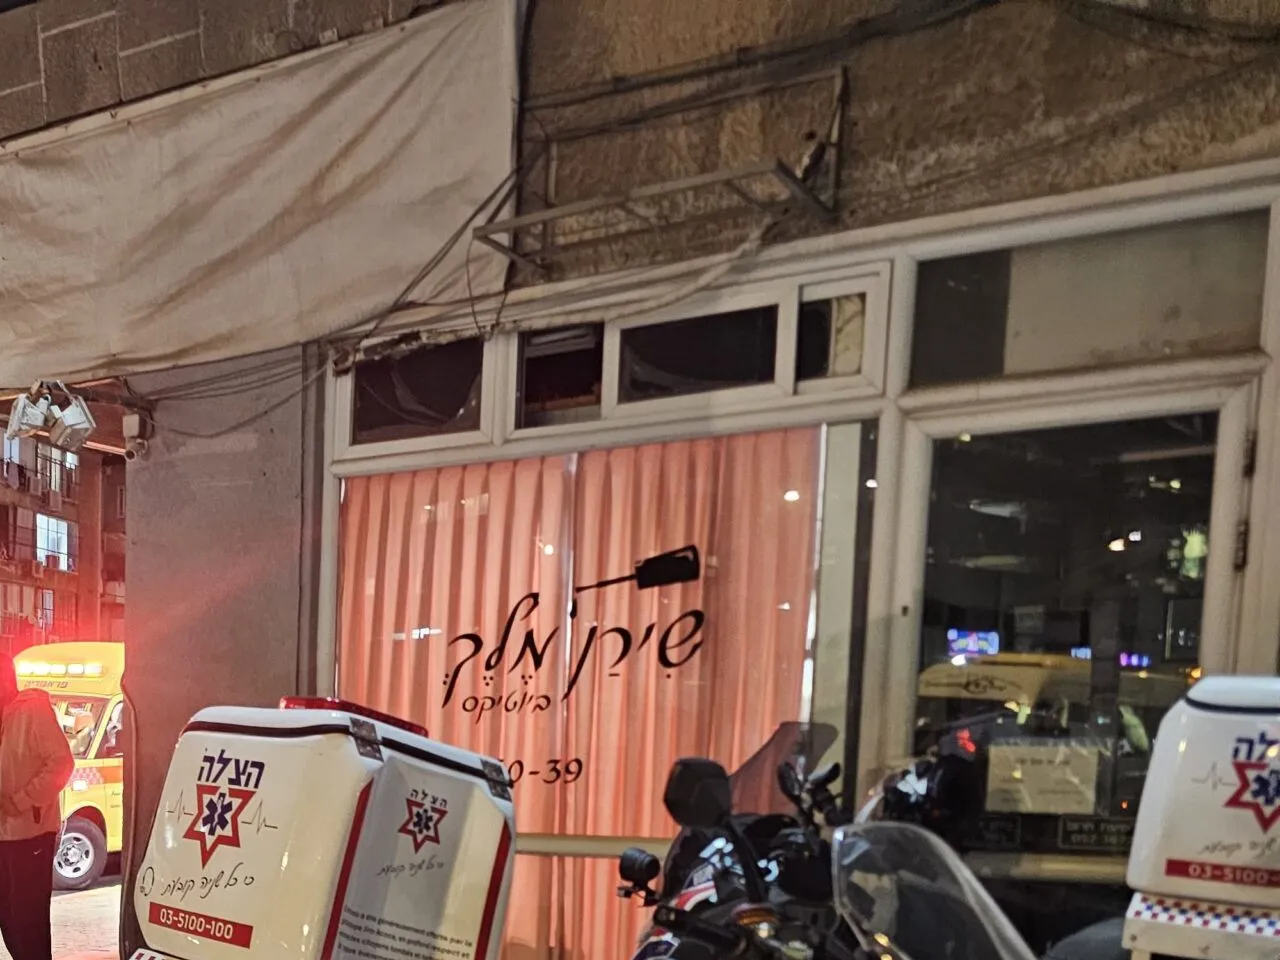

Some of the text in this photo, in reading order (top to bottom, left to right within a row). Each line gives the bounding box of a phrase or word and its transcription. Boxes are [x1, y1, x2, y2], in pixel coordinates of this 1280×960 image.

[197, 748, 266, 789] הצלה
[500, 758, 583, 785] 0-39
[409, 788, 449, 809] הצלה
[160, 907, 234, 940] 03-5100-100
